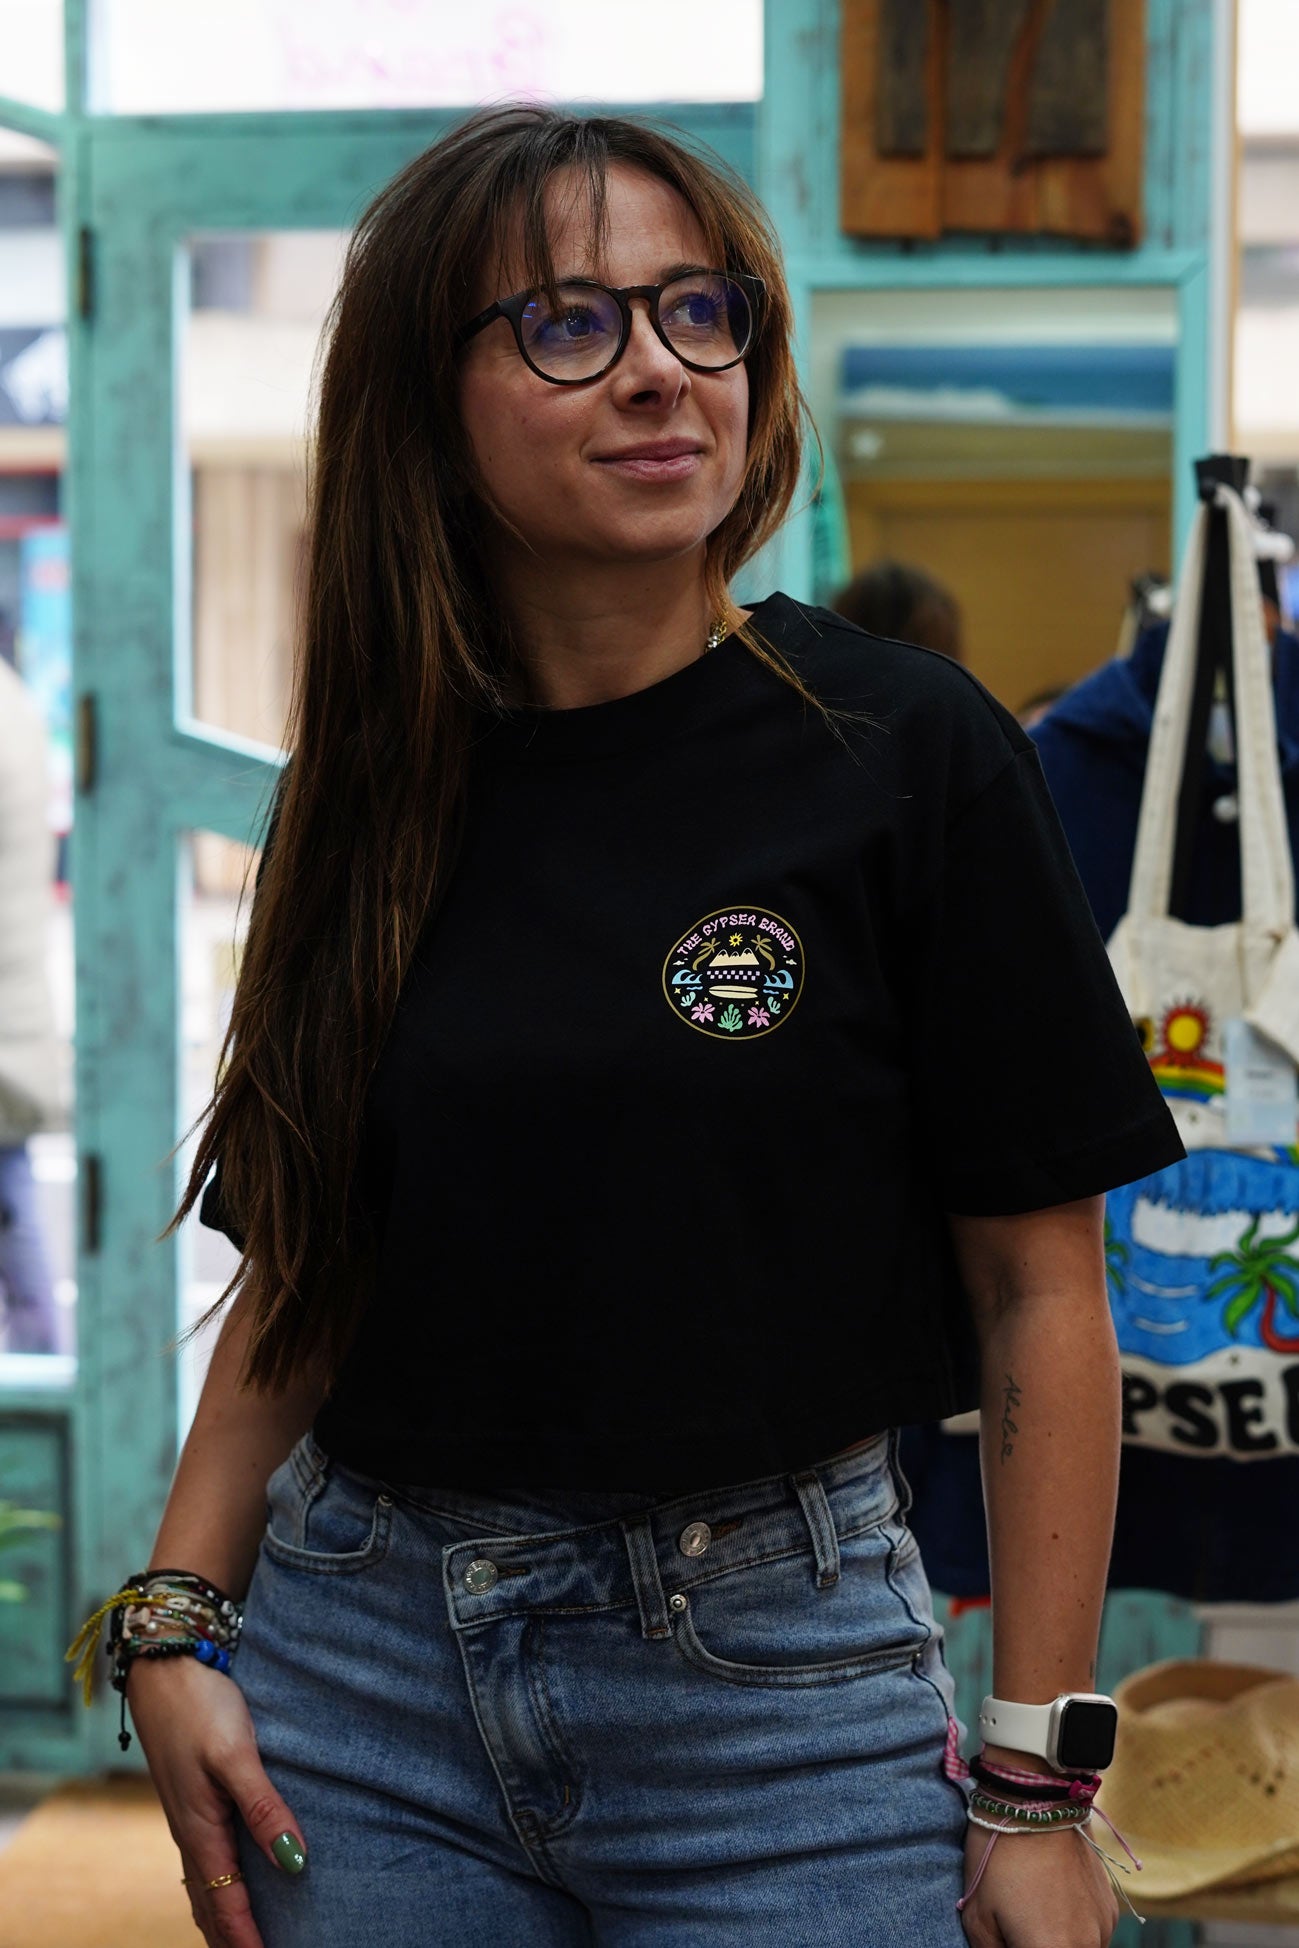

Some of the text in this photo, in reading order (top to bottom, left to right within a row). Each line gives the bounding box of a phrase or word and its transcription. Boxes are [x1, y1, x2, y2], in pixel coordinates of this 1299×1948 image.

[676, 913, 796, 955] THE GYPSER BRAND
